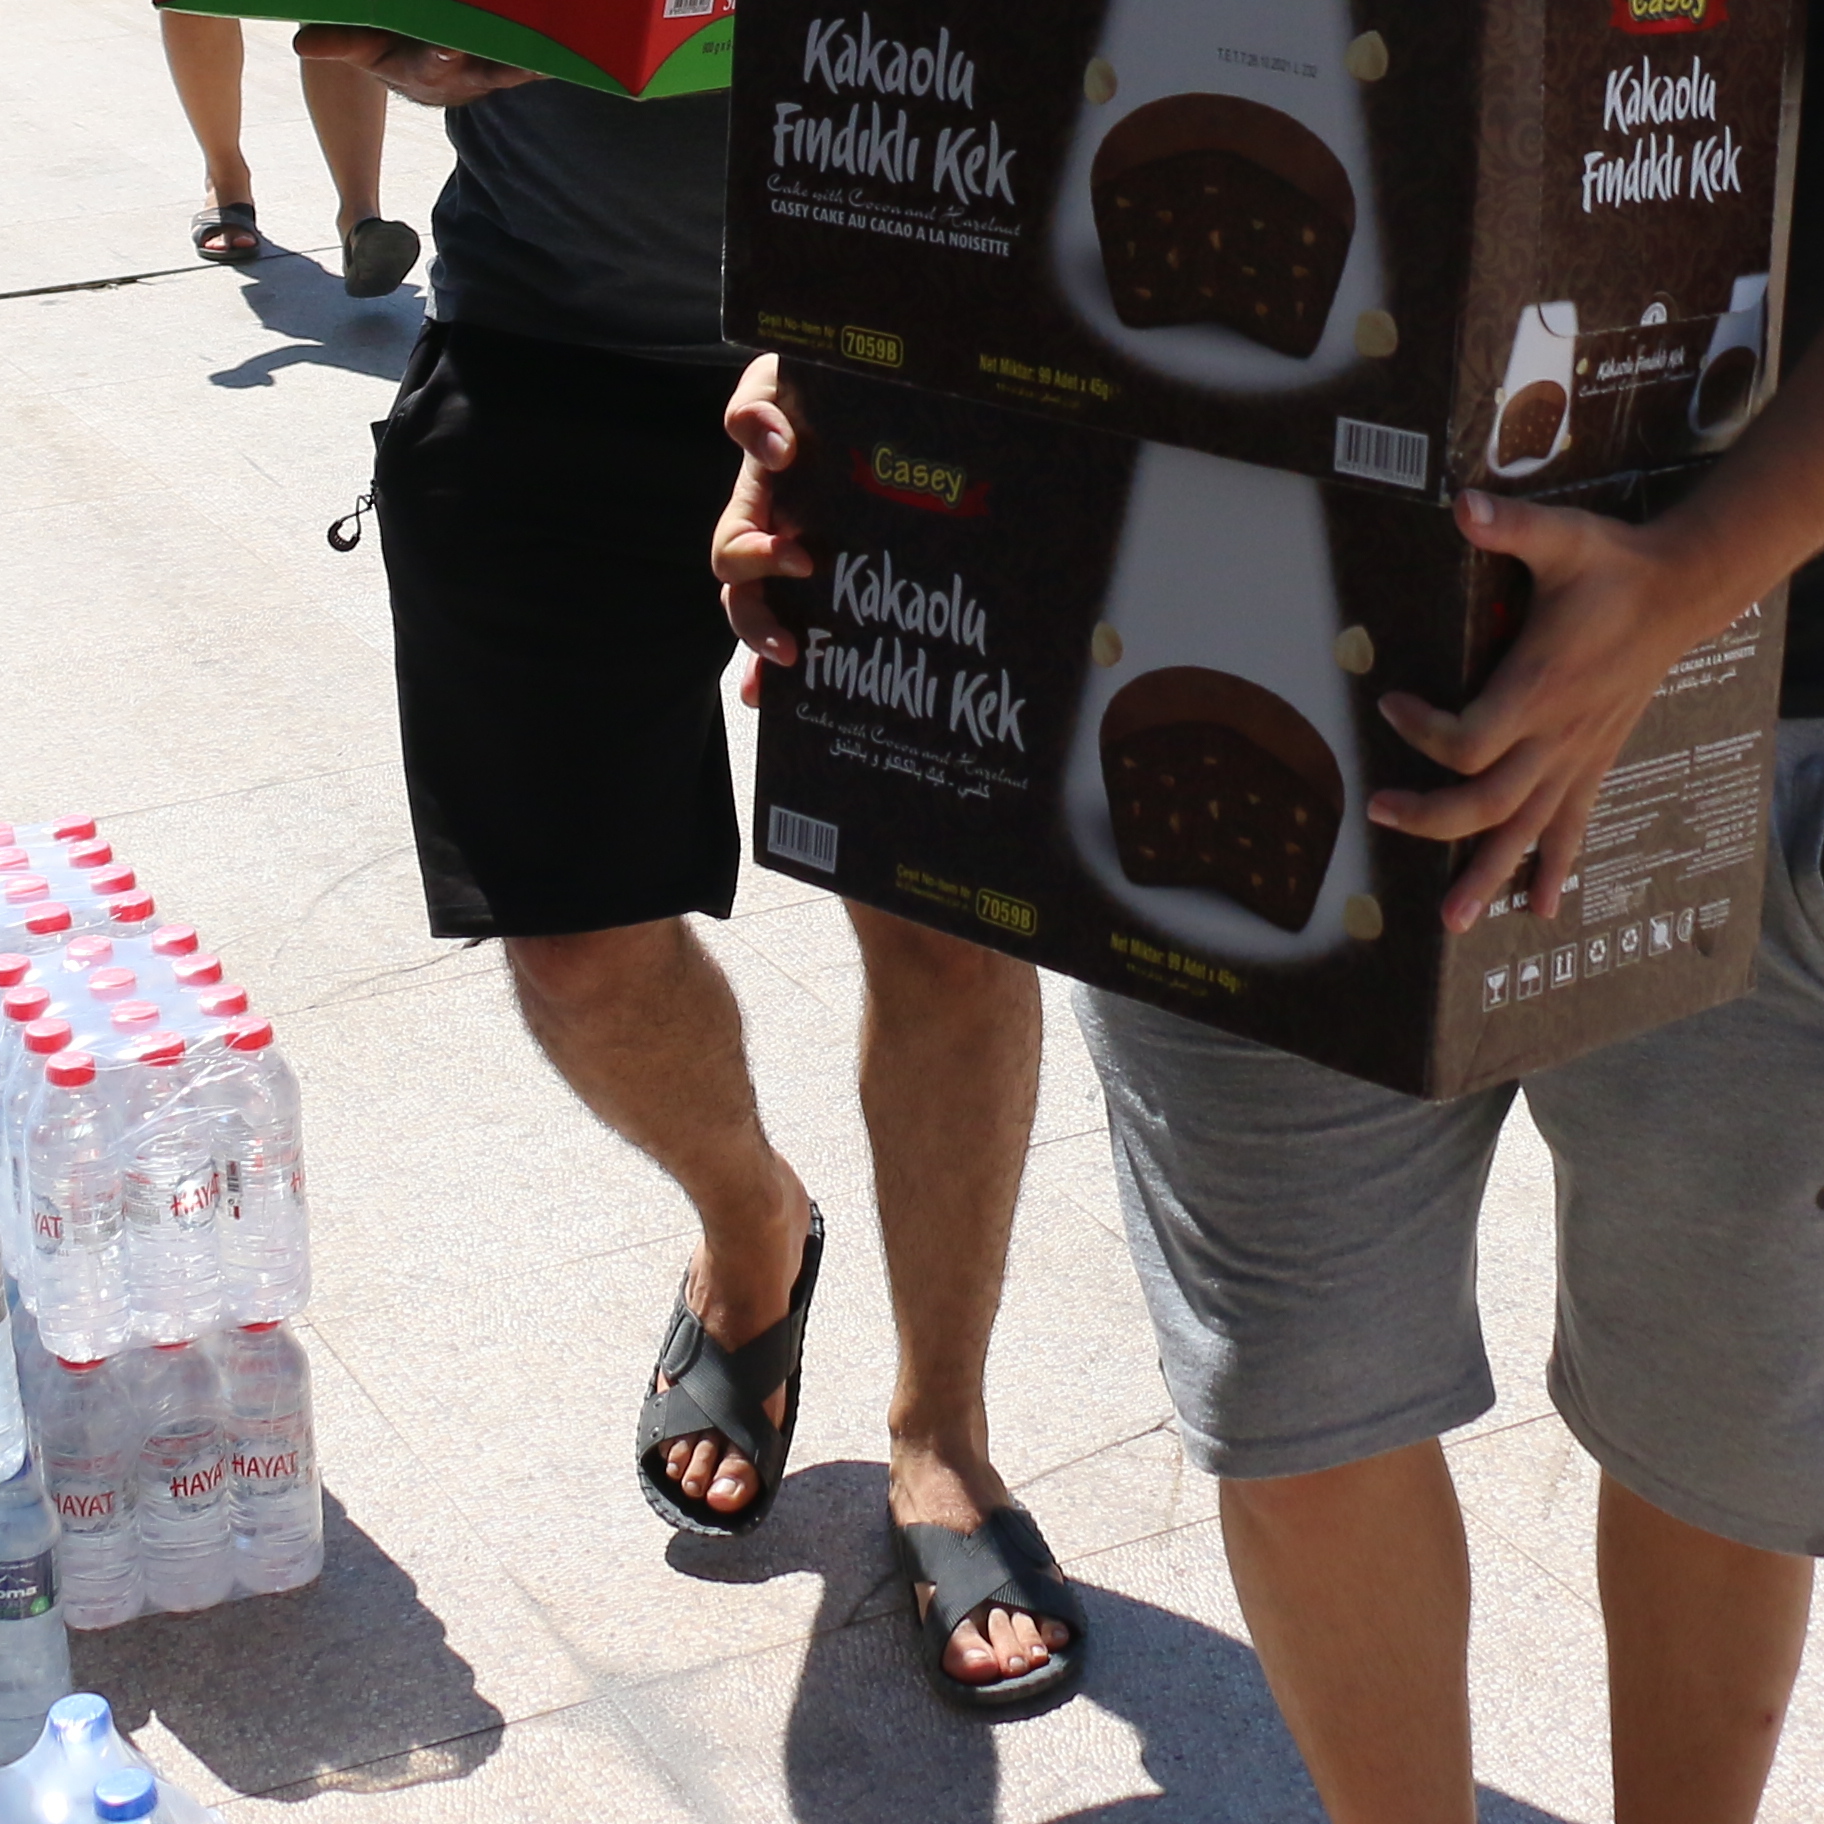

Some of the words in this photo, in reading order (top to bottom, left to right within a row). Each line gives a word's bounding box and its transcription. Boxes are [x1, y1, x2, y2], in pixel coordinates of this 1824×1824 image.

[804, 11, 975, 110] Kakaolu
[1603, 55, 1717, 136] Kakaolu
[773, 101, 920, 184] Fındıklı
[933, 120, 1017, 206] Kek
[1582, 131, 1683, 213] Fındıklı
[1690, 125, 1742, 204] Kek
[771, 199, 810, 221] CASEY
[813, 206, 845, 226] CAKE
[848, 213, 867, 230] AU
[870, 217, 913, 239] CACAO
[915, 226, 926, 241] A
[929, 227, 946, 245] LA
[948, 232, 1011, 258] NOISETTE
[845, 330, 899, 362] 7059B
[979, 353, 997, 371] Net
[874, 447, 964, 503] Casey
[832, 549, 986, 656] Kakaolu
[804, 627, 939, 719] Fındıklı
[949, 668, 1026, 753] Kek
[980, 893, 1032, 929] 7059B
[170, 1172, 220, 1215] HAYA
[31, 1212, 63, 1240] YAT
[170, 1458, 226, 1498] HAYA
[231, 1451, 299, 1479] HAYAT
